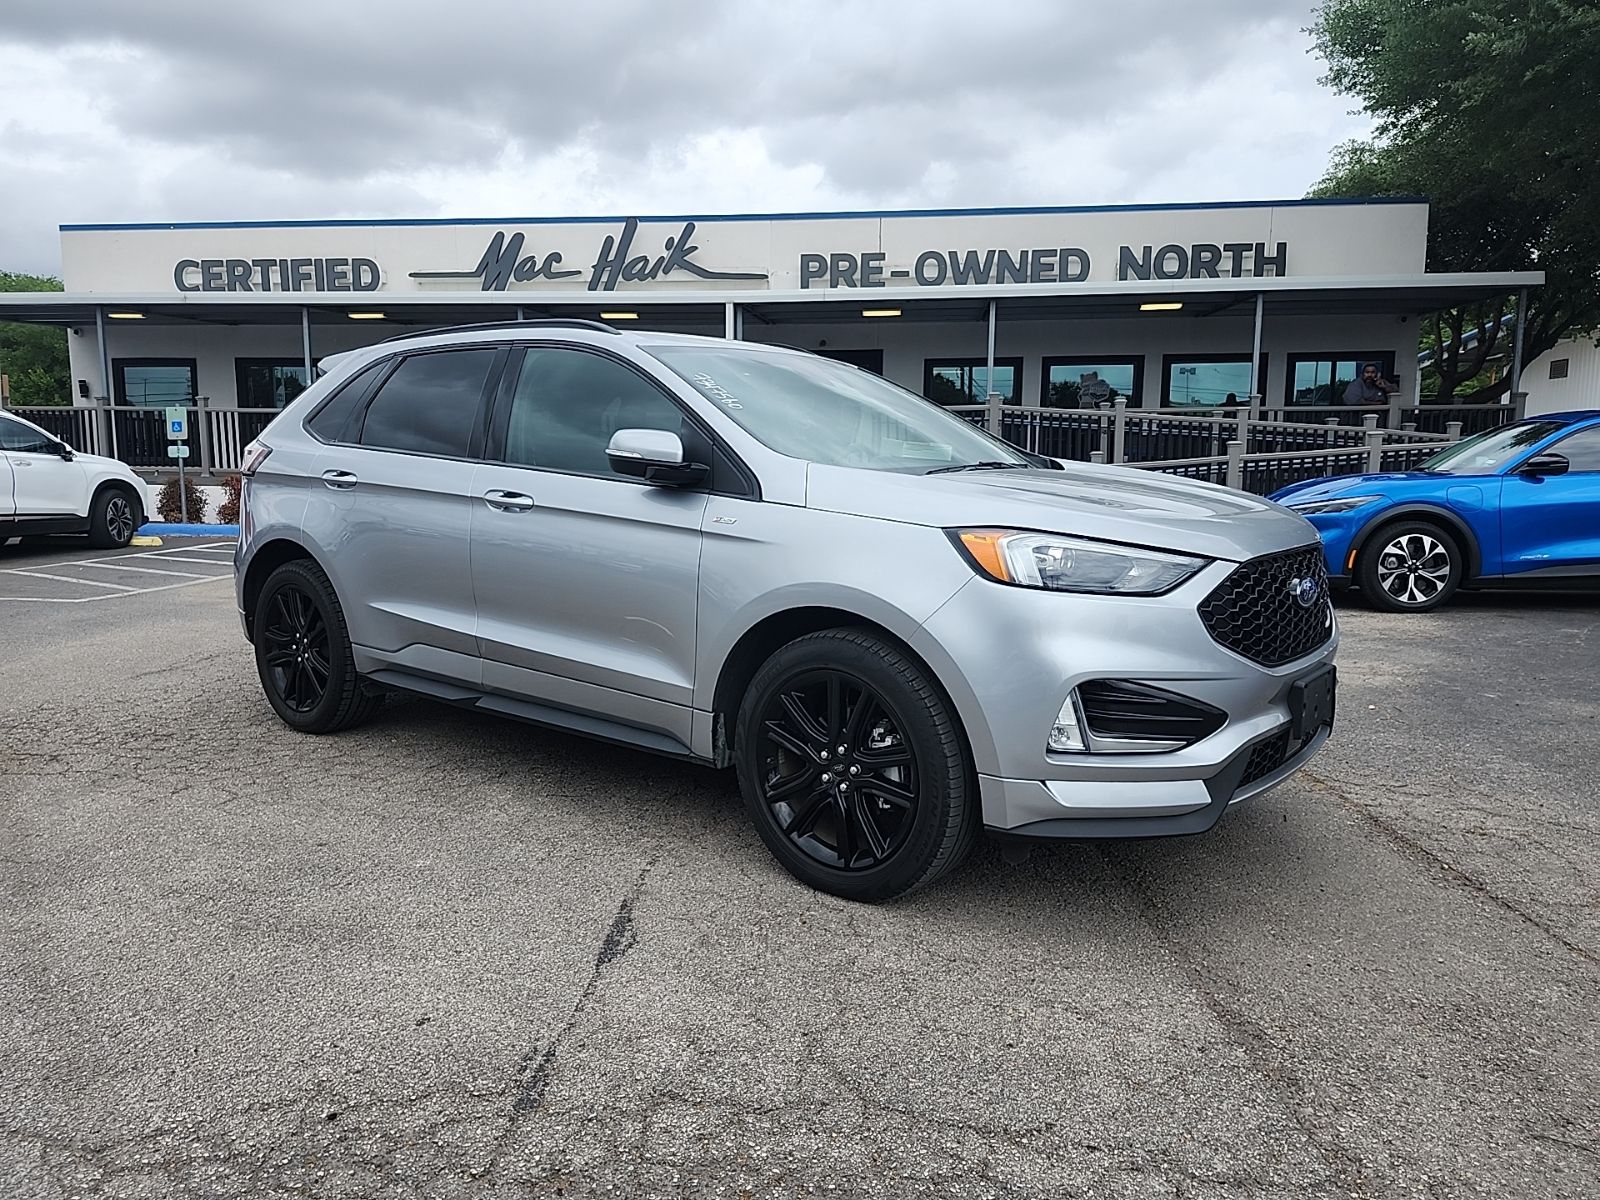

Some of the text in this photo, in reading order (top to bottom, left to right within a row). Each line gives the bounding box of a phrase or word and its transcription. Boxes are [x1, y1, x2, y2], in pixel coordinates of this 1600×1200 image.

[173, 257, 381, 292] CERTIFIED
[408, 217, 769, 291] Mac Haik
[800, 242, 1288, 289] PRE-OWNED NORTH
